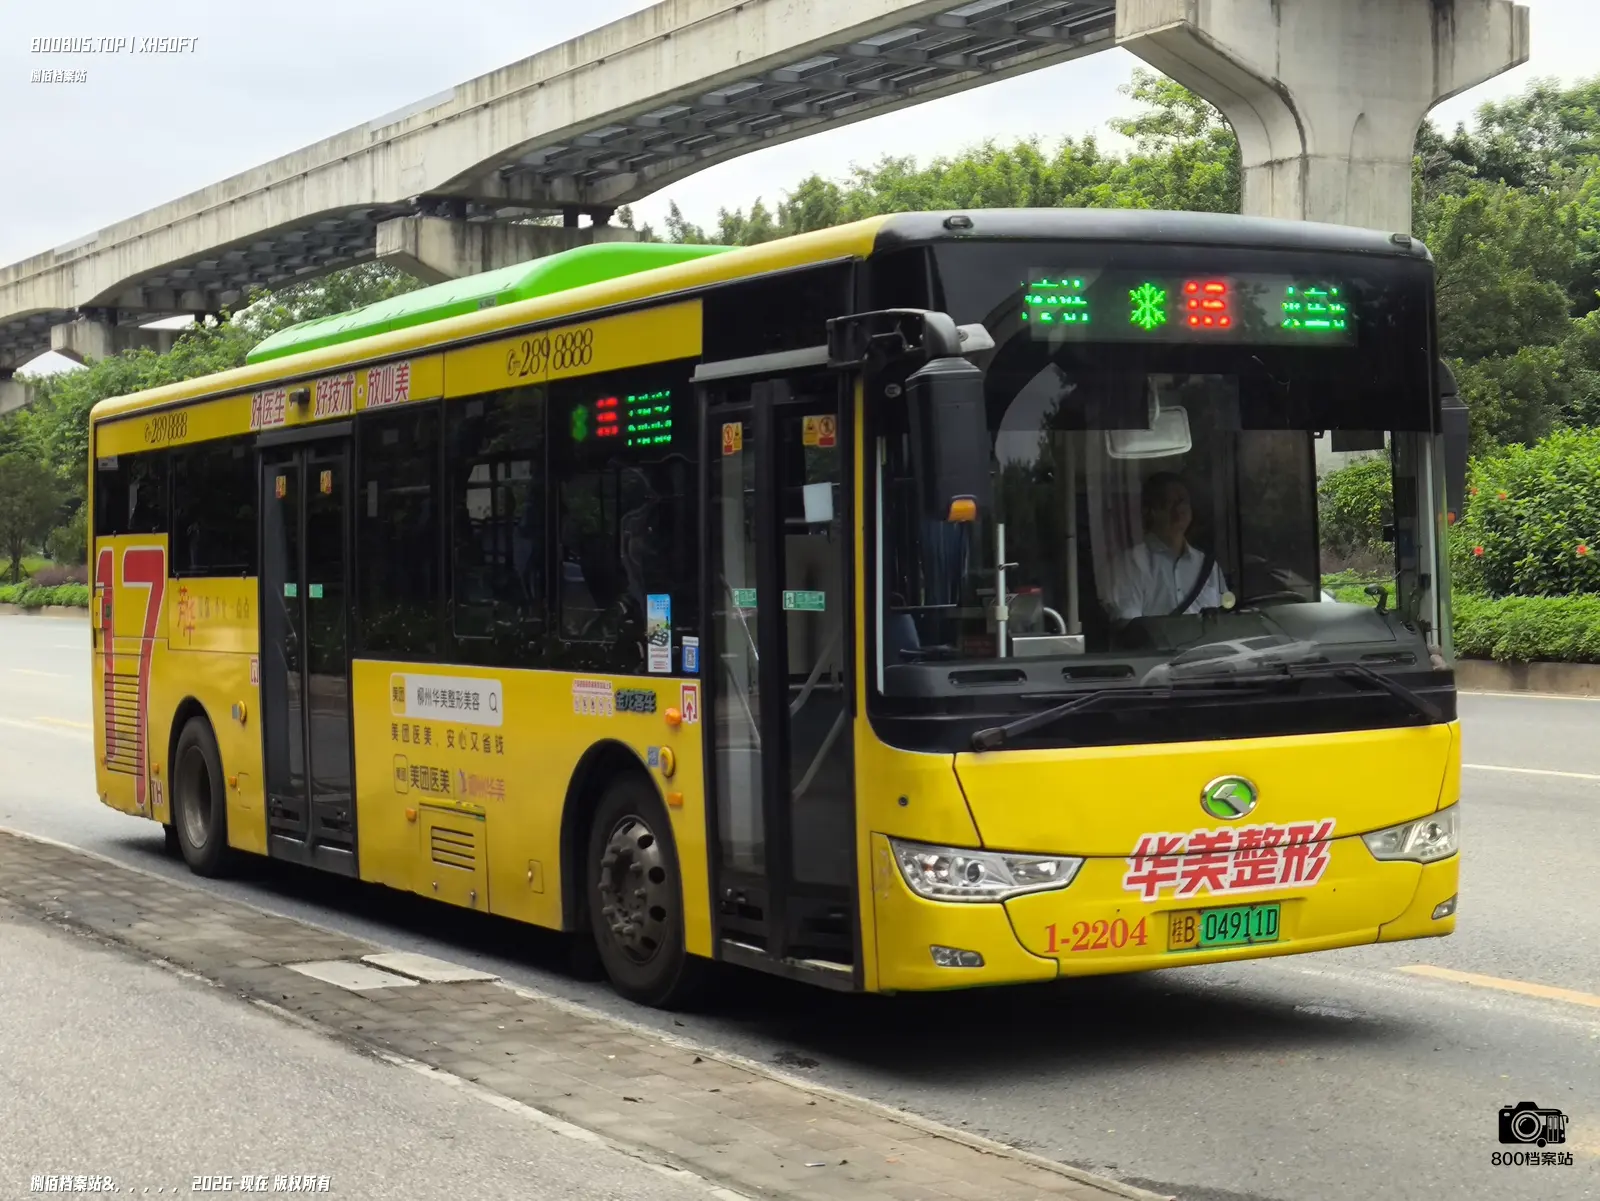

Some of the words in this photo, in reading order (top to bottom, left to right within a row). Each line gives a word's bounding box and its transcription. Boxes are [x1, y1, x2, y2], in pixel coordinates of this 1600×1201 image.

[96, 546, 166, 806] 17
[417, 686, 480, 711] 柳州华美整形美容
[410, 764, 450, 794] 美团医美
[1125, 820, 1334, 898] 华美整形
[1044, 915, 1148, 954] 1-2204
